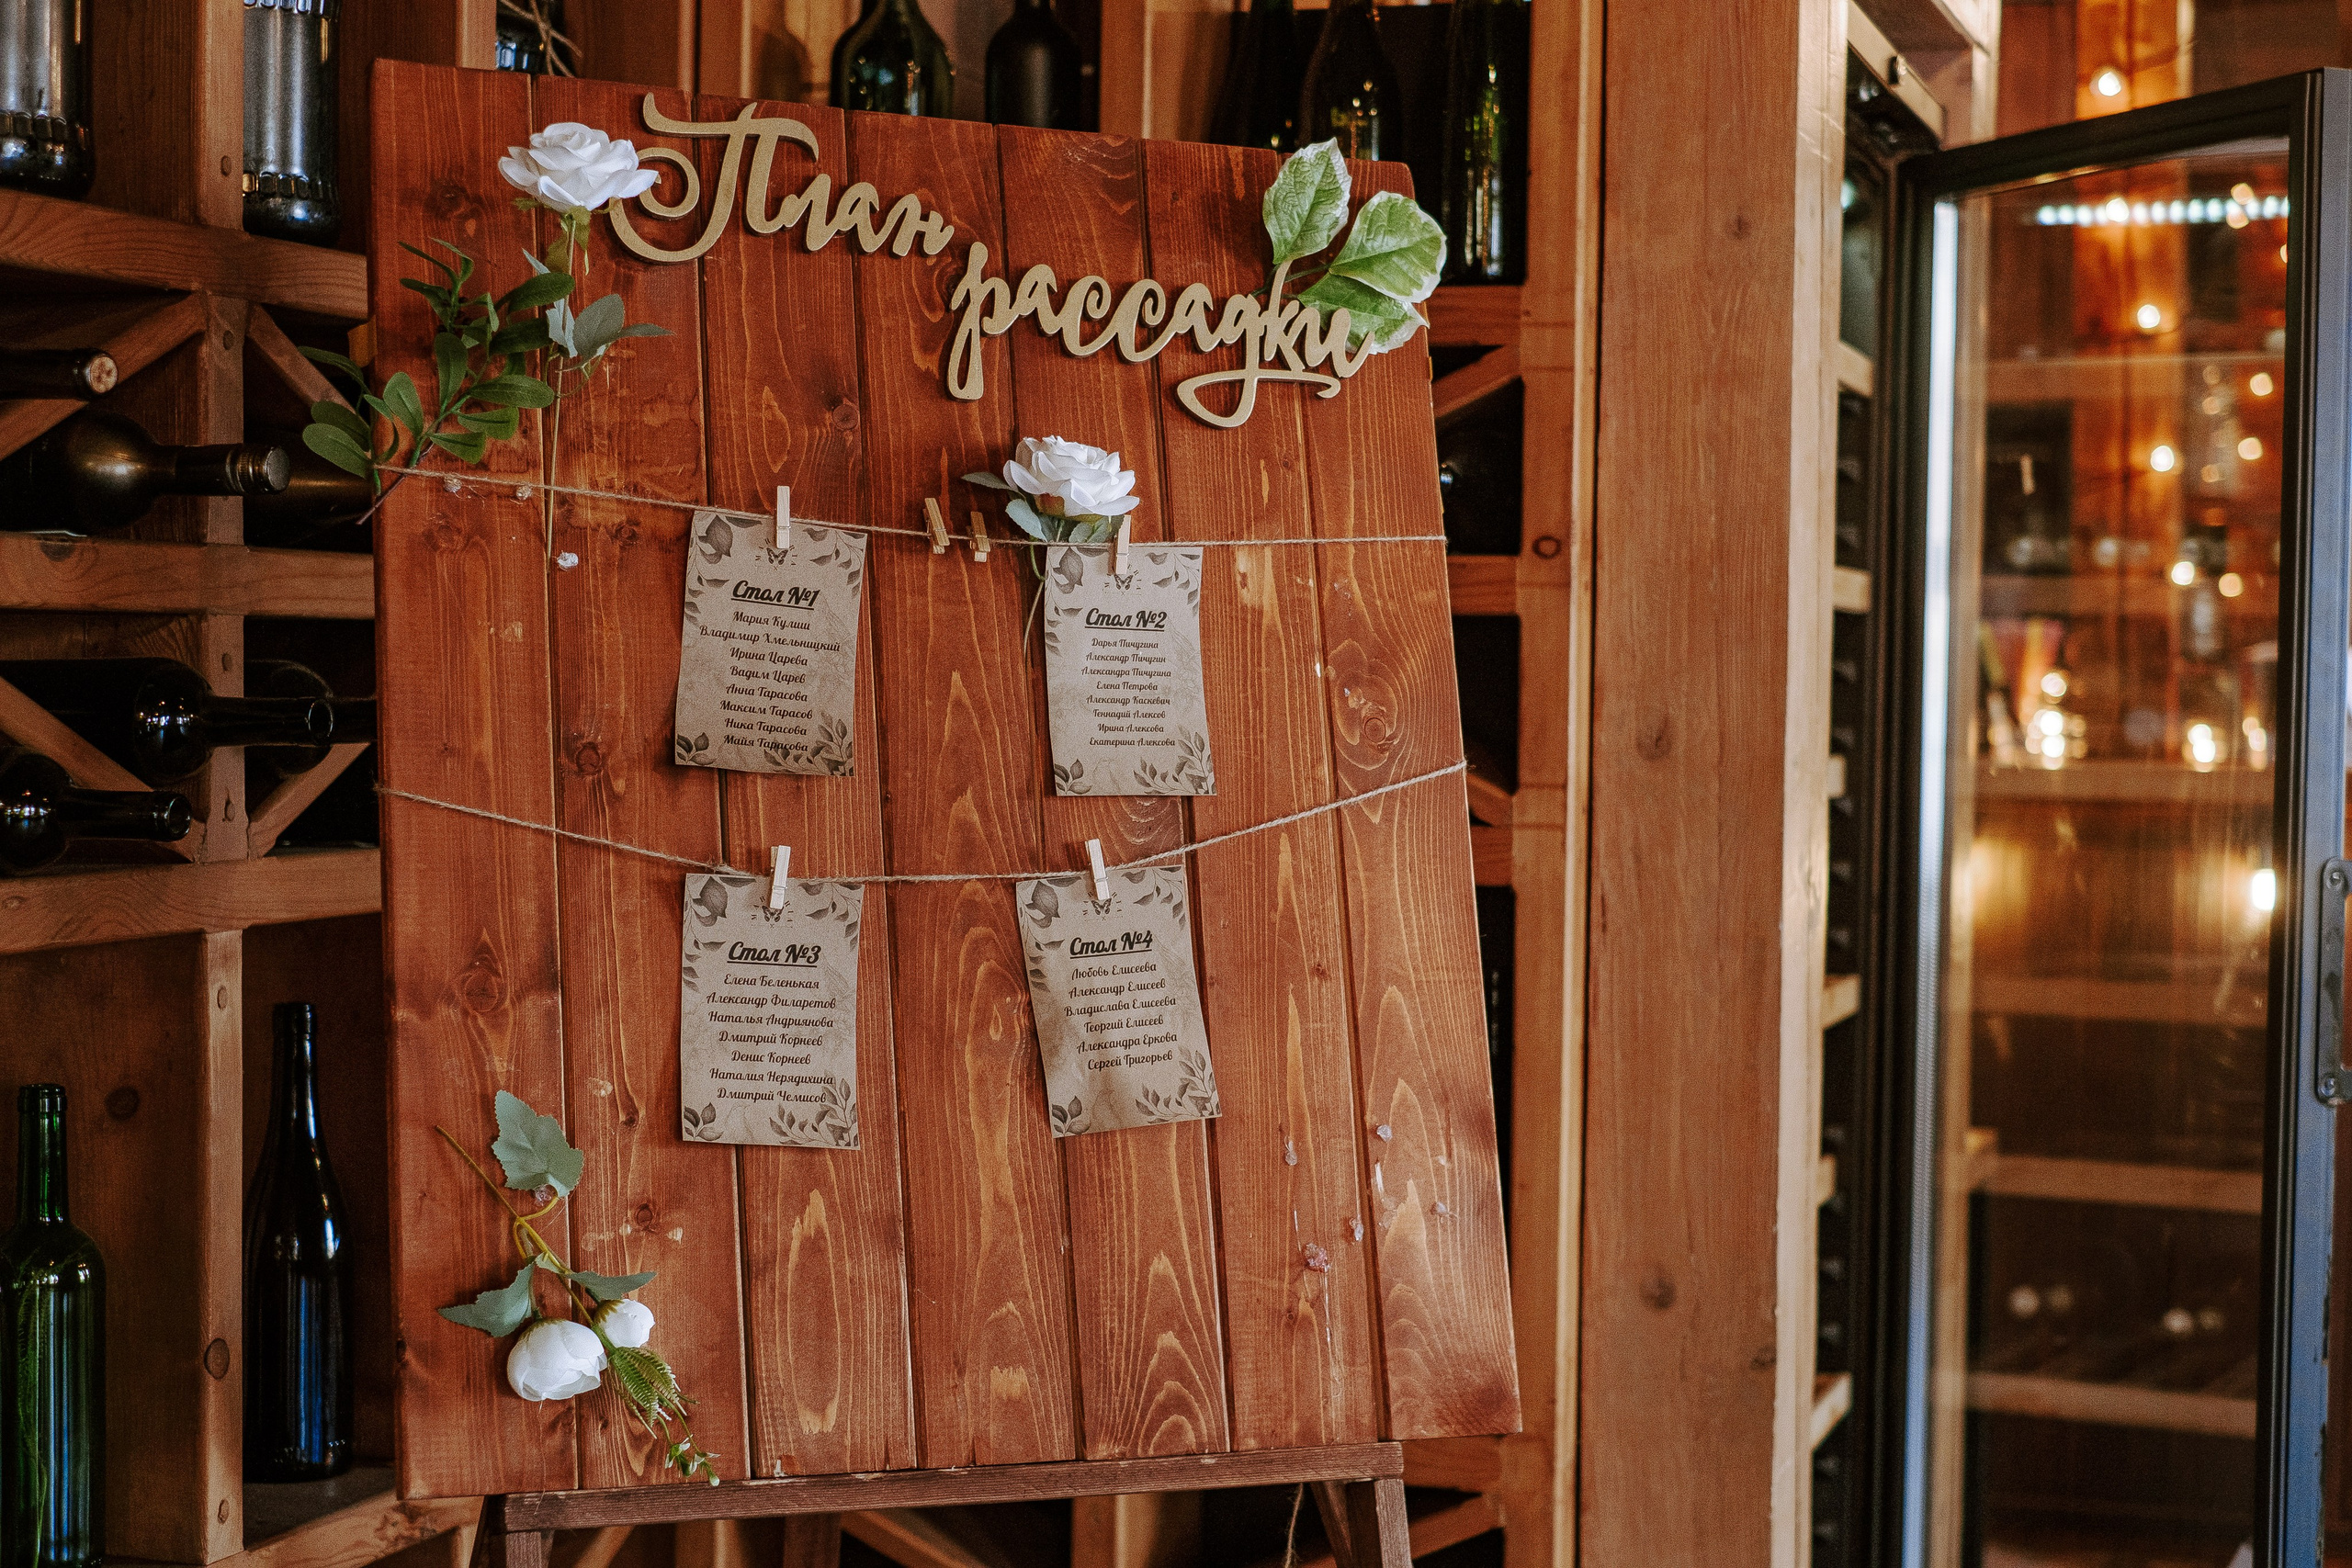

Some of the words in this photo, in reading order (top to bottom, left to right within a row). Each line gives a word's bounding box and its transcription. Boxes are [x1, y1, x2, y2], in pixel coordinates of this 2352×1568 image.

[605, 91, 955, 264] План
[946, 242, 1375, 428] рассадки
[732, 580, 785, 602] Стол
[787, 587, 820, 607] №1
[732, 611, 769, 626] Мария
[772, 616, 810, 630] Кулиш
[1086, 608, 1132, 626] Стол
[1136, 611, 1168, 628] №2
[700, 626, 760, 644] Владимир
[763, 633, 841, 652] Хмельницкий
[1091, 637, 1117, 649] Дарья
[1119, 639, 1159, 650] Пичугина
[730, 647, 765, 661] Ирина
[768, 651, 808, 666] Царева
[1086, 652, 1129, 663] Александр
[1132, 654, 1166, 664] Пичугин
[730, 666, 769, 681] Вадим
[772, 671, 806, 683] Царев
[1081, 667, 1130, 678] Александра
[1132, 668, 1171, 679] Пичугина
[725, 683, 755, 696] Анна
[758, 687, 808, 702] Тарасова
[1096, 682, 1120, 690] Елена
[1122, 682, 1158, 692] Петрова
[720, 700, 767, 715] Максим
[769, 705, 813, 719] Тарасов
[1086, 695, 1130, 706] Александр
[1093, 709, 1131, 720] Геннадий
[1133, 710, 1166, 718] Алексов
[724, 718, 753, 730] Ника
[757, 721, 808, 736] Тарасова
[1097, 724, 1125, 733] Ирина
[1126, 724, 1164, 733] Алексова
[723, 735, 754, 747] Майя
[757, 738, 808, 751] Тарасова
[1090, 738, 1135, 748] Екатерина
[1136, 738, 1175, 746] Алексова
[1070, 937, 1117, 955] Стол
[1121, 930, 1153, 951] №4
[729, 941, 781, 962] Стол
[785, 943, 821, 964] №3
[1071, 966, 1109, 981] Любовь
[1112, 962, 1157, 976] Елисеева
[724, 974, 757, 987] Елена
[760, 976, 820, 989] Беленькая
[1069, 984, 1125, 998] Александр
[1128, 978, 1166, 991] Елисеев
[707, 991, 768, 1008] Александр
[771, 995, 836, 1010] Филаретов
[1064, 1001, 1130, 1018] Владислава
[1132, 996, 1176, 1009] Елисеева
[708, 1011, 763, 1024] Наталья
[765, 1014, 833, 1029] Андриянова
[1084, 1019, 1124, 1033] Георгий
[1126, 1015, 1164, 1028] Елисеев
[718, 1031, 776, 1045] Дмитрий
[779, 1033, 823, 1048] Корнеев
[1077, 1039, 1140, 1054] Александра
[1143, 1032, 1177, 1045] Еркова
[731, 1050, 764, 1062] Денис
[768, 1052, 811, 1066] Корнеев
[1088, 1056, 1122, 1071] Сергей
[1124, 1050, 1173, 1067] Григорьев
[709, 1068, 764, 1081] Наталия
[767, 1071, 833, 1086] Нерядихина
[718, 1088, 775, 1102] Дмитрий
[777, 1090, 827, 1103] Чемисов
